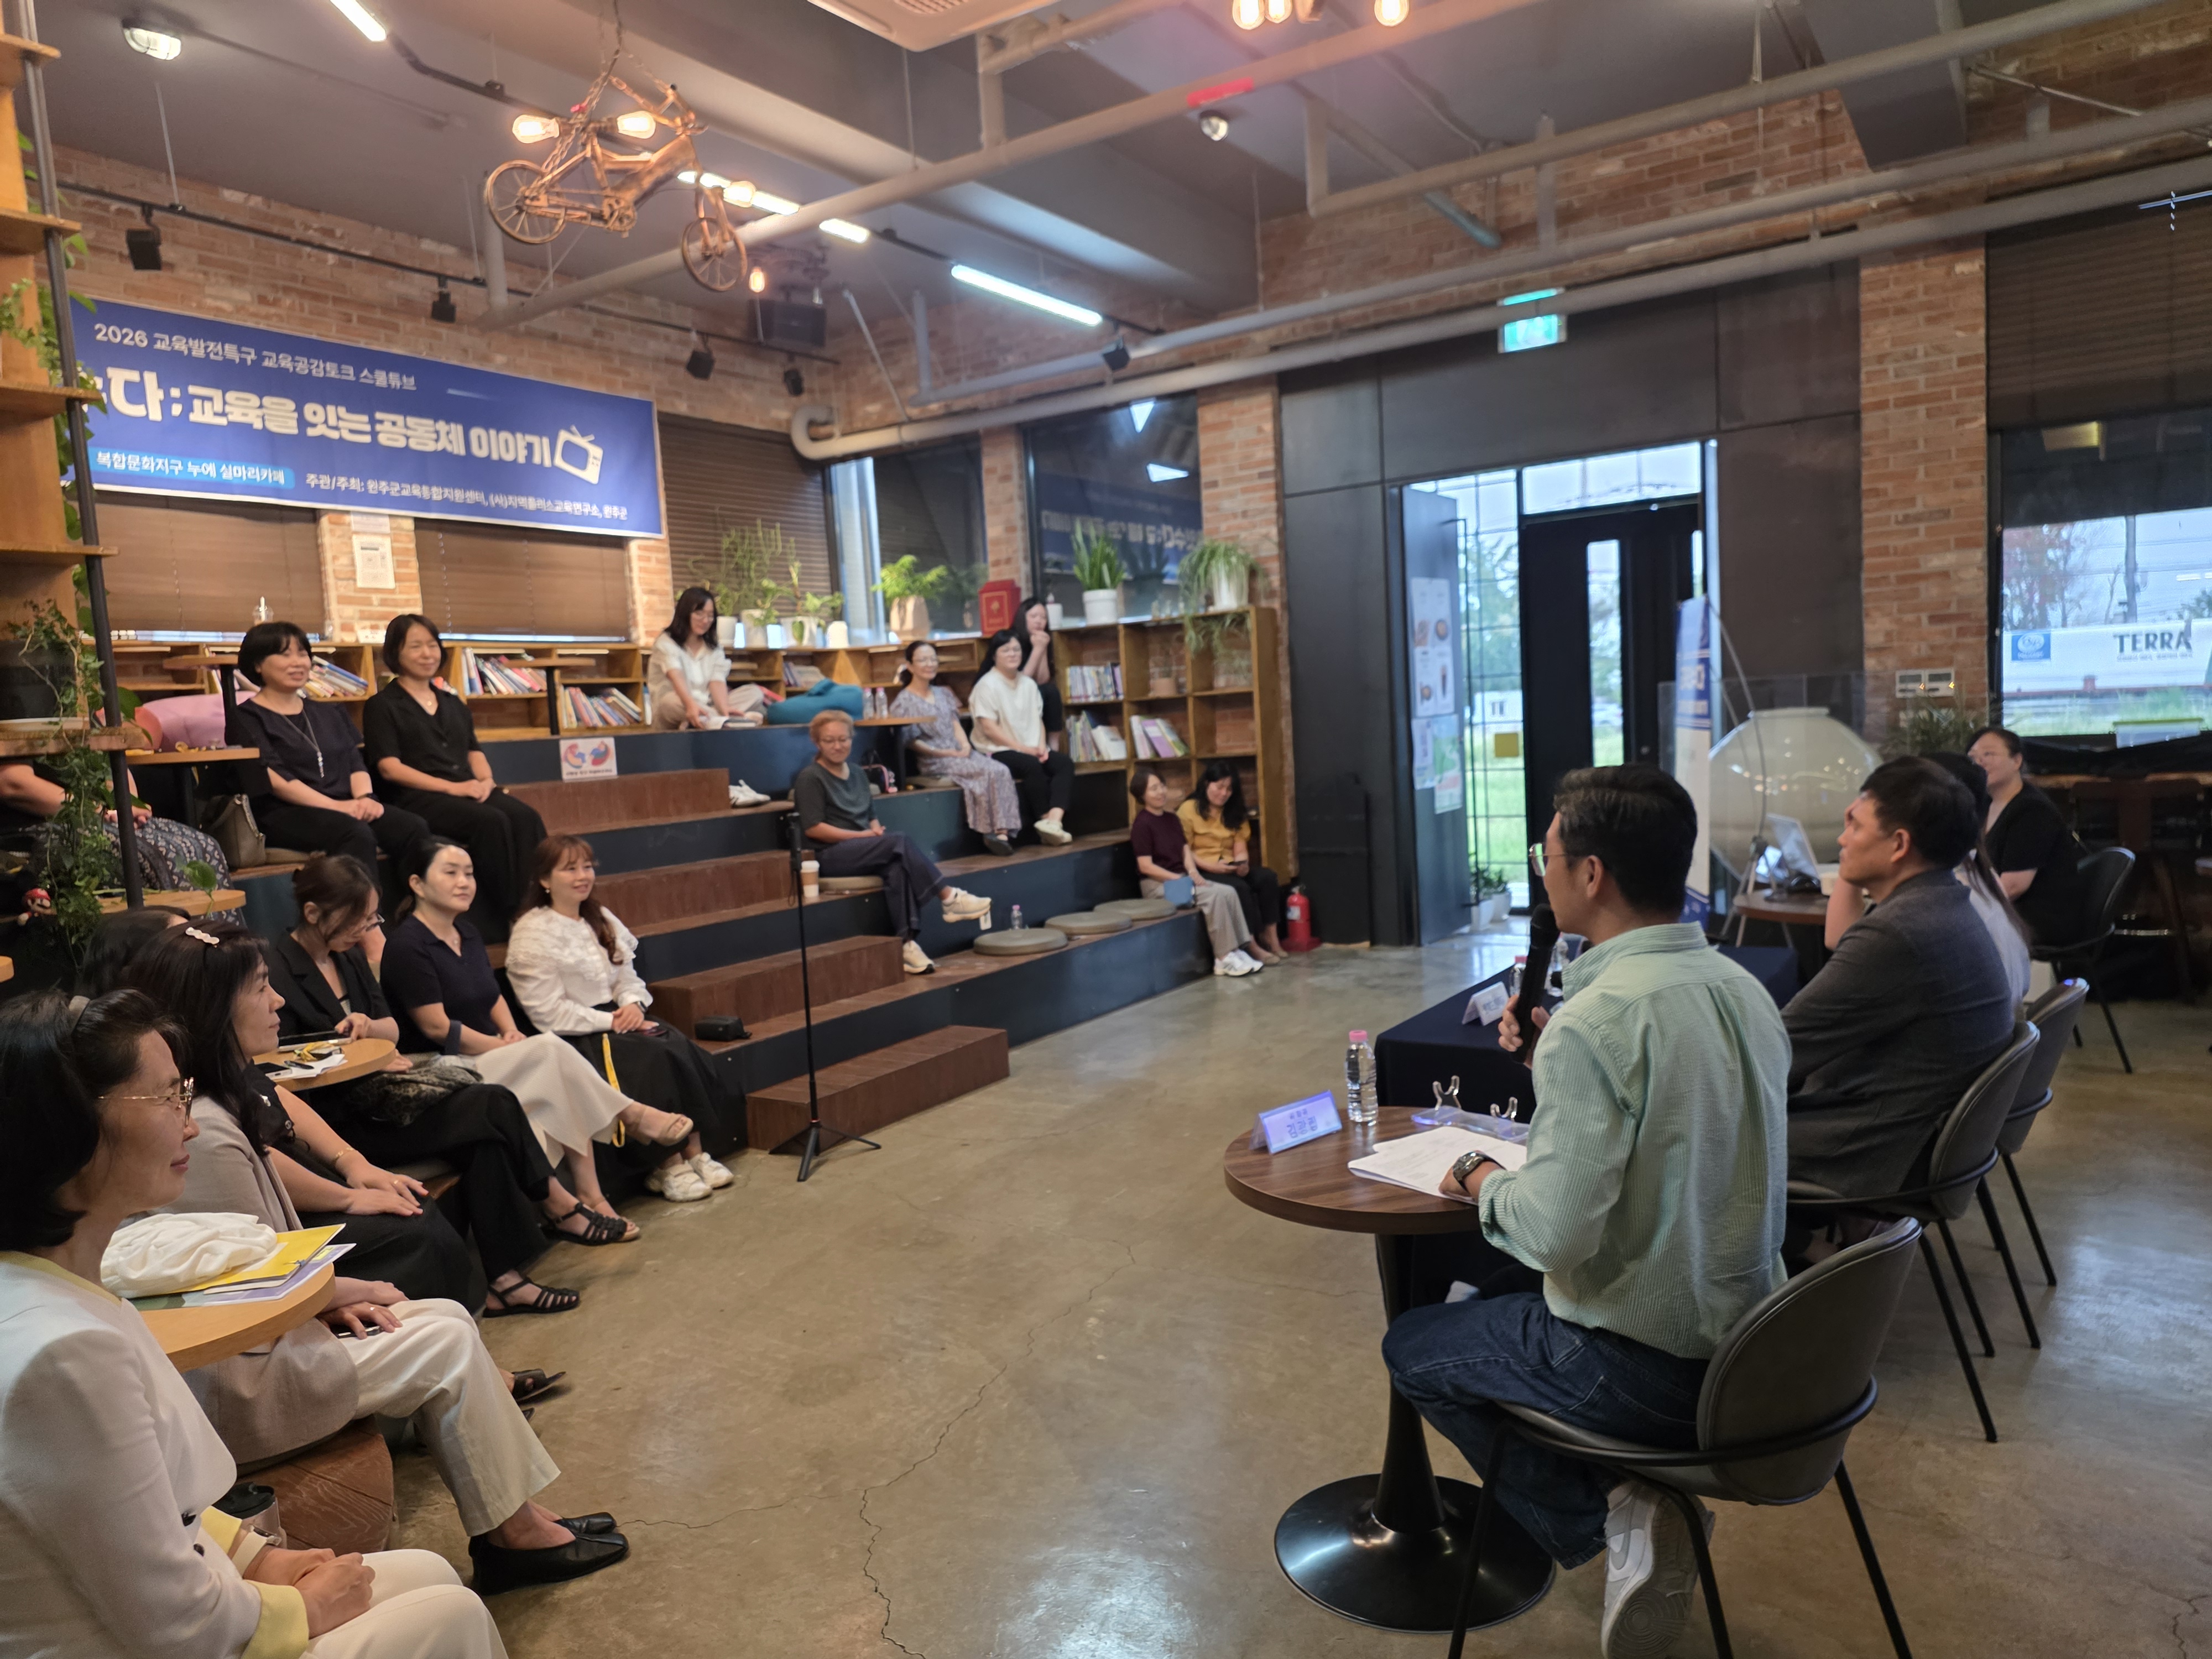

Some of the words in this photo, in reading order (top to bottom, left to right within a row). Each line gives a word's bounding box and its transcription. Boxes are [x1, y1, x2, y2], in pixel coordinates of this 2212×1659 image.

[94, 323, 148, 348] 2026
[153, 332, 257, 366] 교육발전특구
[187, 384, 299, 435] 교육을
[374, 410, 466, 456] 공동체
[469, 426, 552, 468] 이야기
[96, 451, 183, 476] 복합문화지구
[187, 461, 217, 478] 누에
[2113, 632, 2193, 653] TERRA
